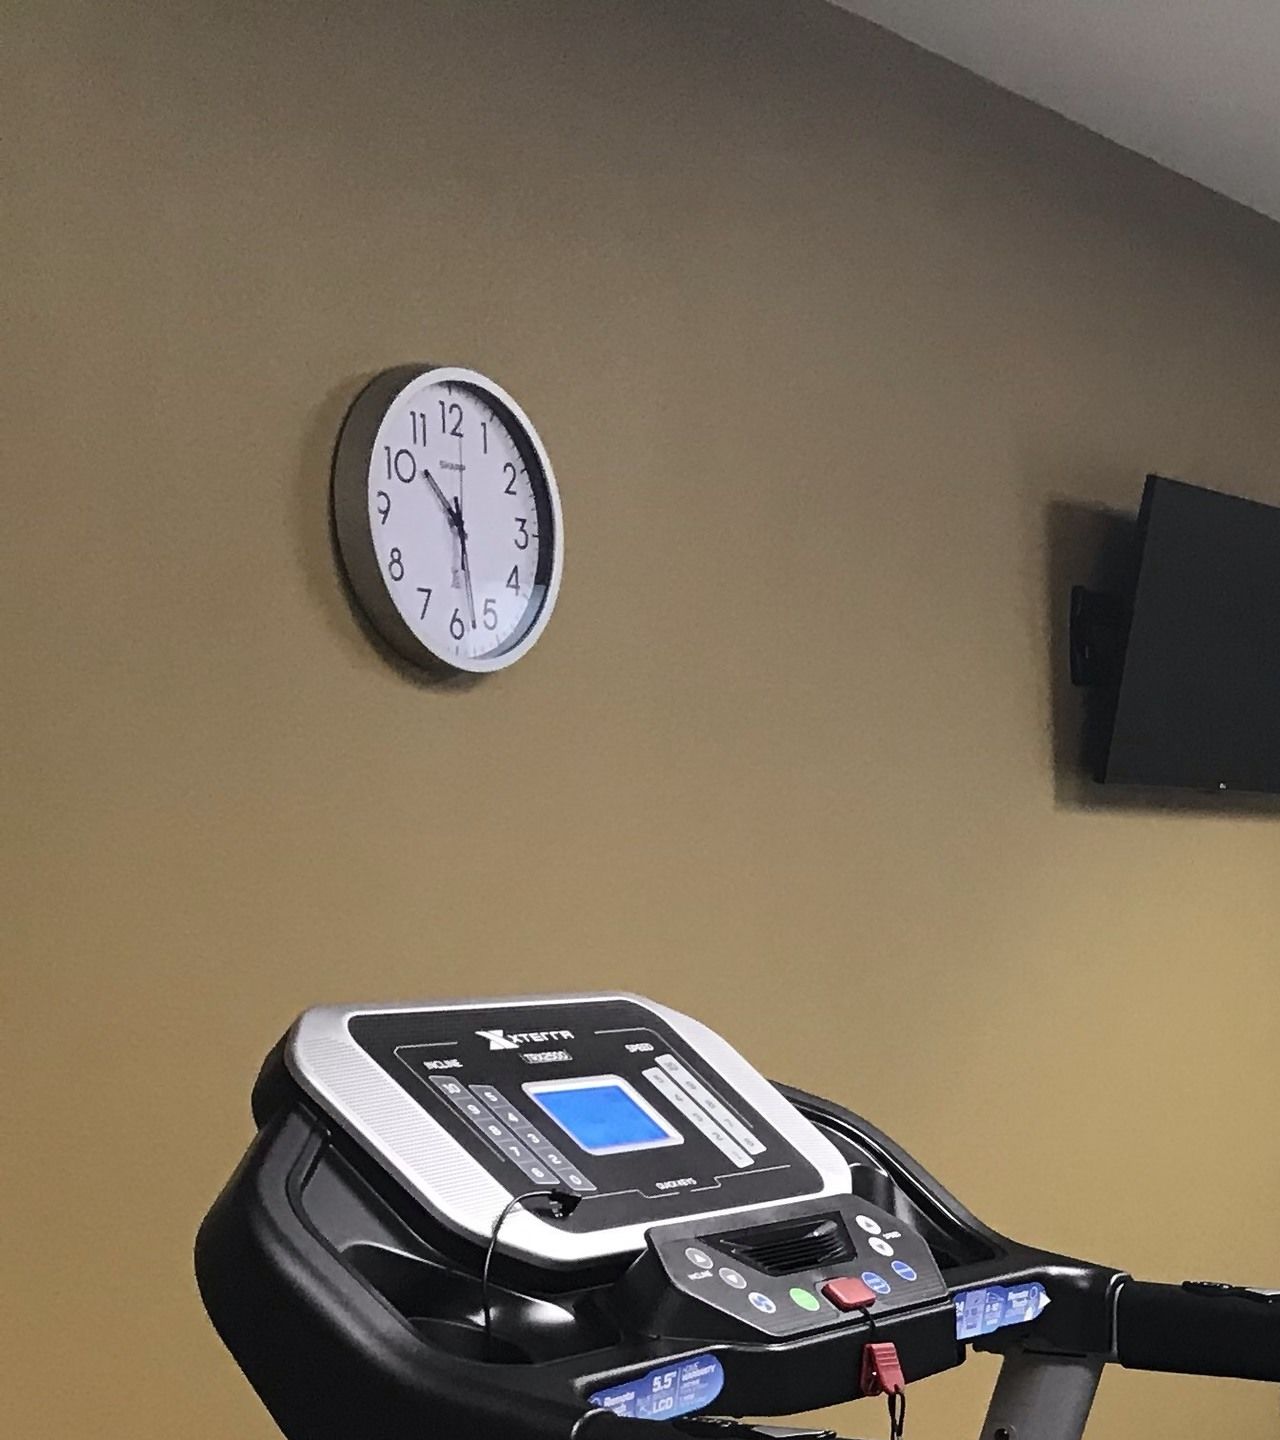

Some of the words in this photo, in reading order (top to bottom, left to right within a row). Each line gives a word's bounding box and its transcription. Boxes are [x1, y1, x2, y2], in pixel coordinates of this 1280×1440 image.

[410, 411, 427, 447] 11
[439, 400, 463, 437] 12
[481, 422, 487, 454] 1
[384, 446, 416, 483] 10
[503, 463, 517, 495] 2
[376, 491, 391, 525] 9
[514, 518, 529, 550] 3
[388, 548, 404, 581] 8
[506, 565, 520, 596] 4
[416, 588, 432, 620] 7
[483, 599, 498, 630] 5
[449, 608, 465, 640] 6
[484, 1092, 498, 1102] 5
[548, 1154, 562, 1164] 2
[652, 1397, 673, 1413] LCD
